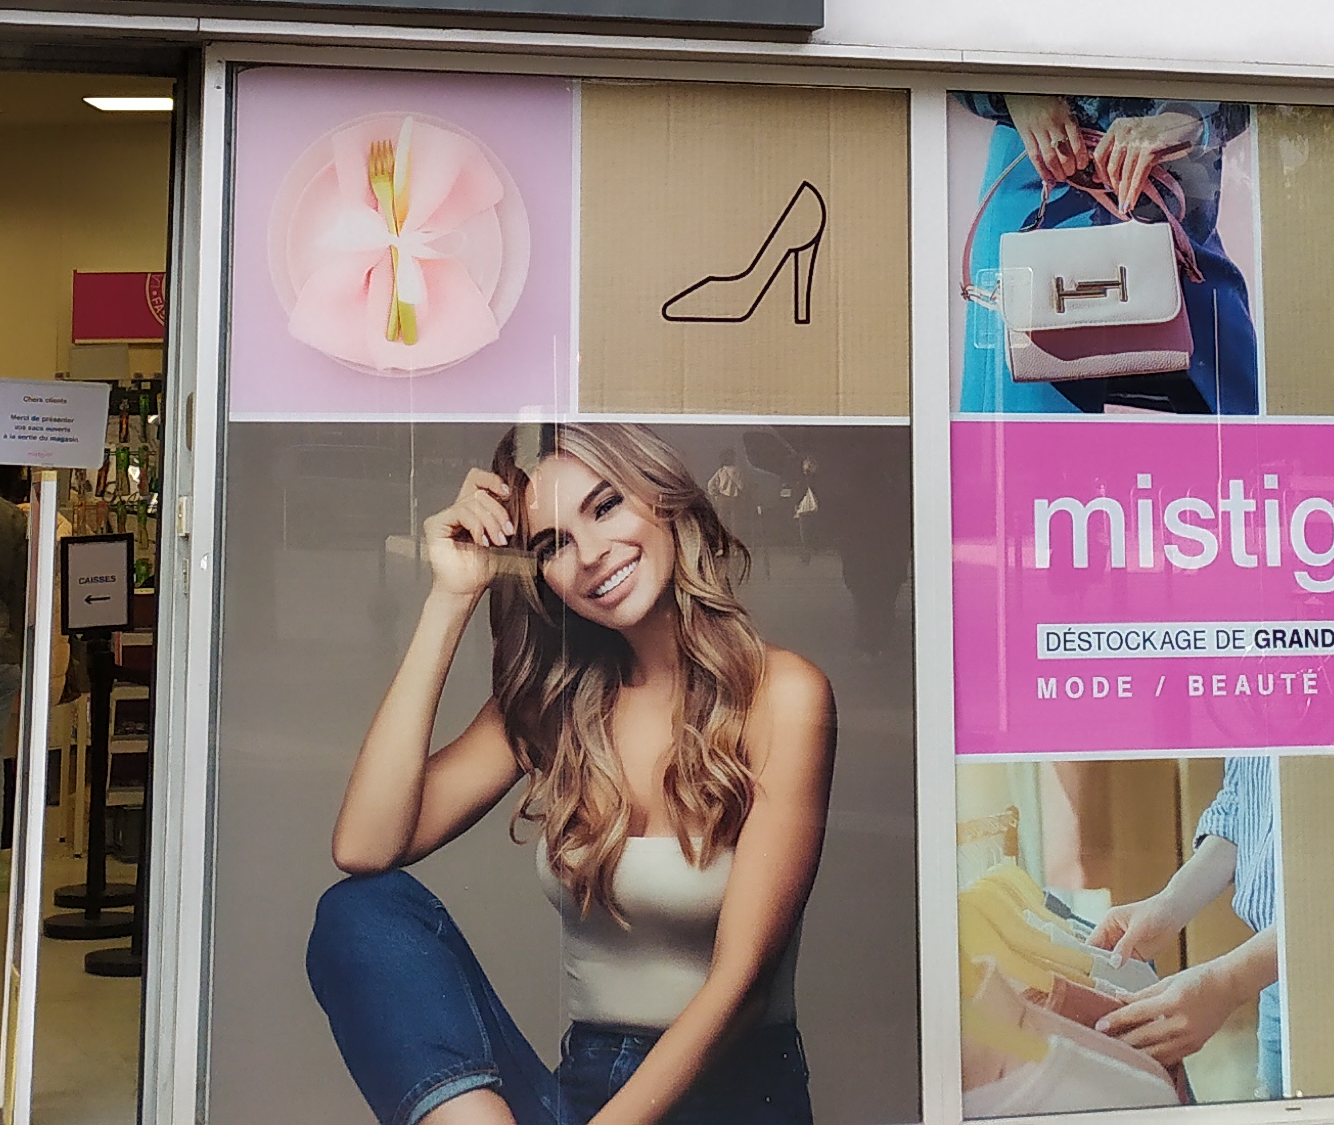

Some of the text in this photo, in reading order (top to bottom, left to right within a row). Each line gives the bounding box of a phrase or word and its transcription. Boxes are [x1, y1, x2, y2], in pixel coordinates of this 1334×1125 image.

[78, 575, 117, 585] CAISSES
[1045, 626, 1207, 652] DÉSTOCKAGE
[1215, 629, 1246, 650] DE
[1037, 676, 1134, 700] MODE
[1188, 668, 1319, 696] BEAUTÉ
